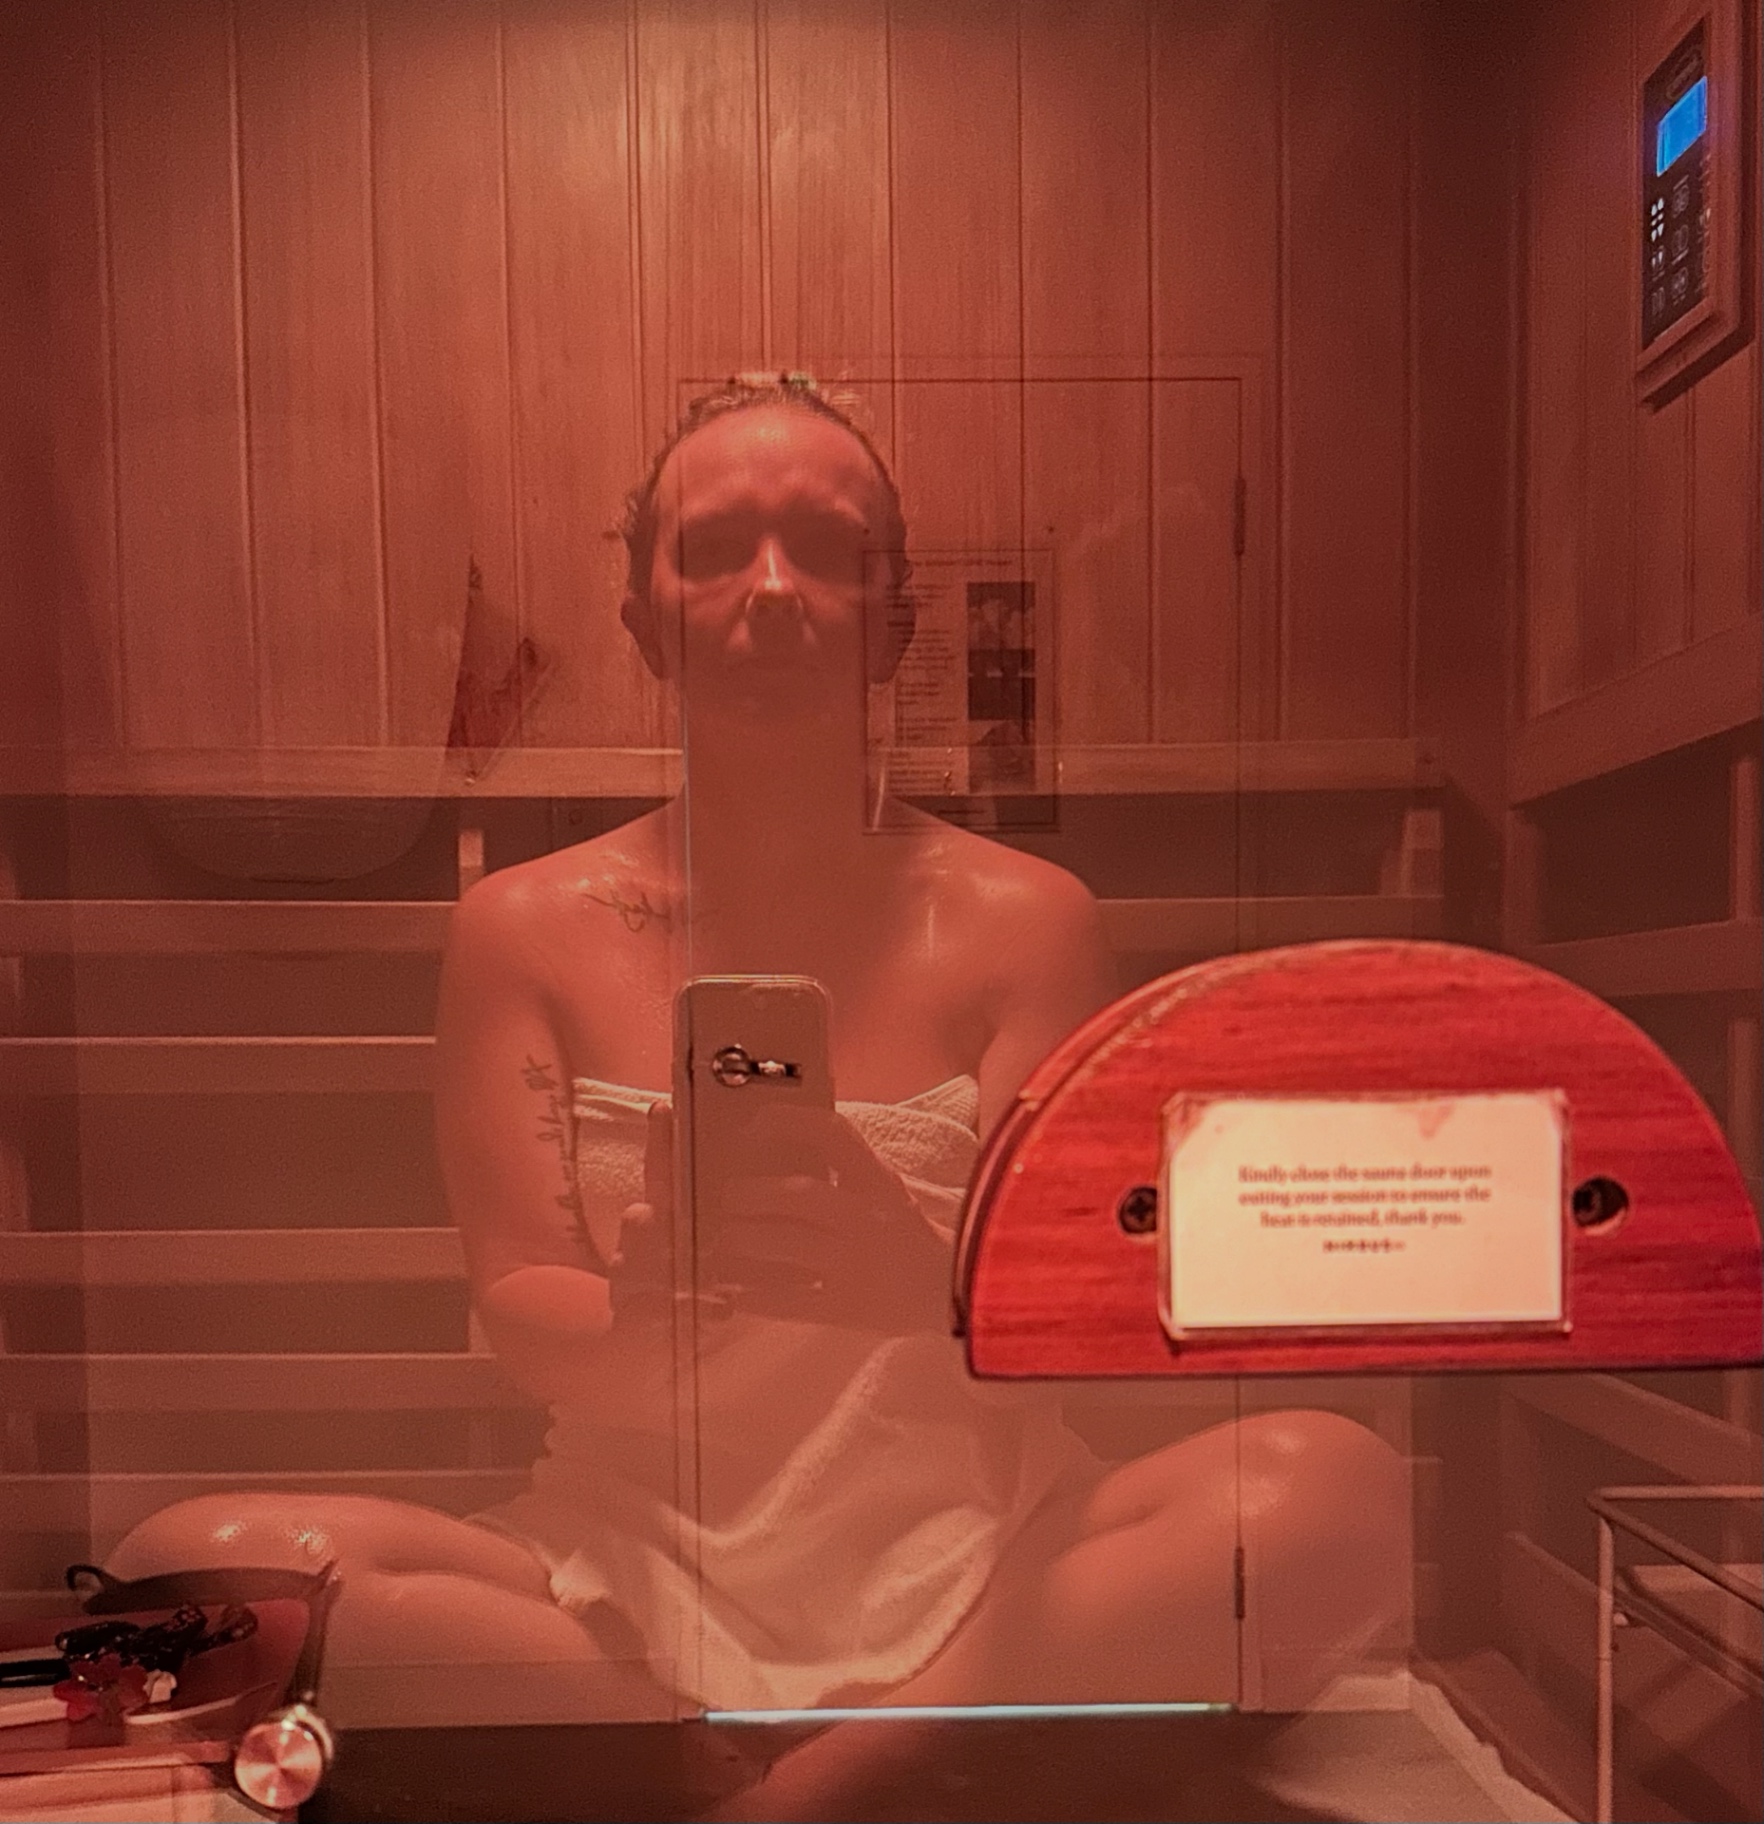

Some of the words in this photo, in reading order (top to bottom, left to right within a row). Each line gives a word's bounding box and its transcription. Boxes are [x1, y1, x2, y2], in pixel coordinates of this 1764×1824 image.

[1290, 1164, 1329, 1182] close
[1333, 1164, 1357, 1181] the
[1361, 1168, 1406, 1181] sauna
[1410, 1162, 1446, 1179] door
[1450, 1166, 1492, 1182] upon
[1238, 1191, 1291, 1207] exiting
[1294, 1193, 1329, 1206] your
[1332, 1189, 1386, 1203] session
[1391, 1190, 1407, 1202] to
[1411, 1190, 1461, 1203] ensure
[1465, 1185, 1491, 1201] the
[1260, 1211, 1295, 1228] heat
[1299, 1212, 1312, 1227] is
[1385, 1209, 1428, 1225] thank
